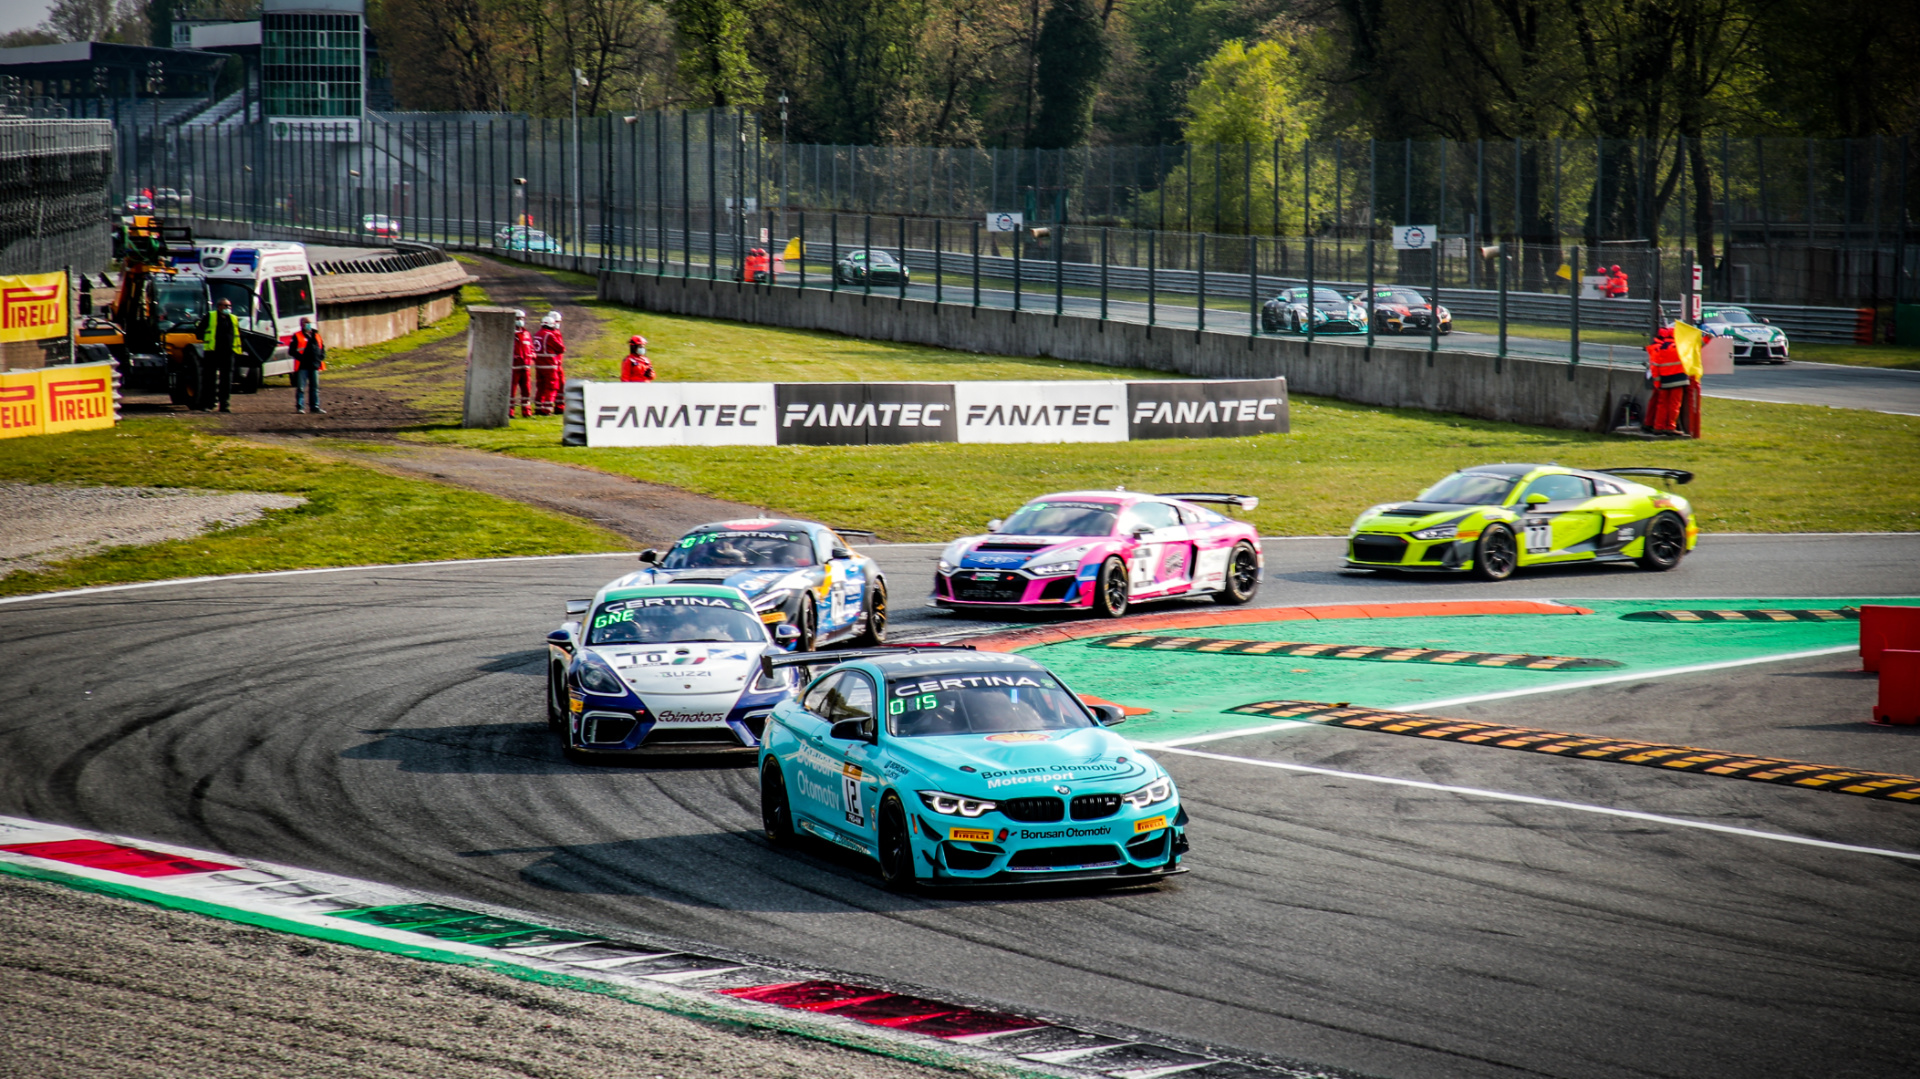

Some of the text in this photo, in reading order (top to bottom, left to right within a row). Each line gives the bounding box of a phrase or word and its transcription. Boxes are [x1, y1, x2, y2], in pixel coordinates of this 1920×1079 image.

[3, 285, 59, 329] PIRELLI
[48, 378, 107, 422] PIRELLI
[595, 404, 763, 429] FANATEC
[782, 403, 945, 428] FANATEC
[965, 404, 1115, 426] FANATEC
[1132, 397, 1279, 425] FANATEC
[717, 531, 788, 541] CERTINA
[604, 597, 731, 614] CERTINA
[594, 609, 635, 629] GNE
[895, 676, 1041, 697] CERTINA
[981, 763, 1118, 780] Borusan Otomotiv
[987, 771, 1075, 790] Motorsport
[797, 769, 840, 812] Otomotiv
[845, 778, 860, 815] 12
[1020, 825, 1112, 840] Borusan Otomotiv
[1137, 816, 1166, 831] PIRELLI
[953, 829, 990, 840] PIRELLI
